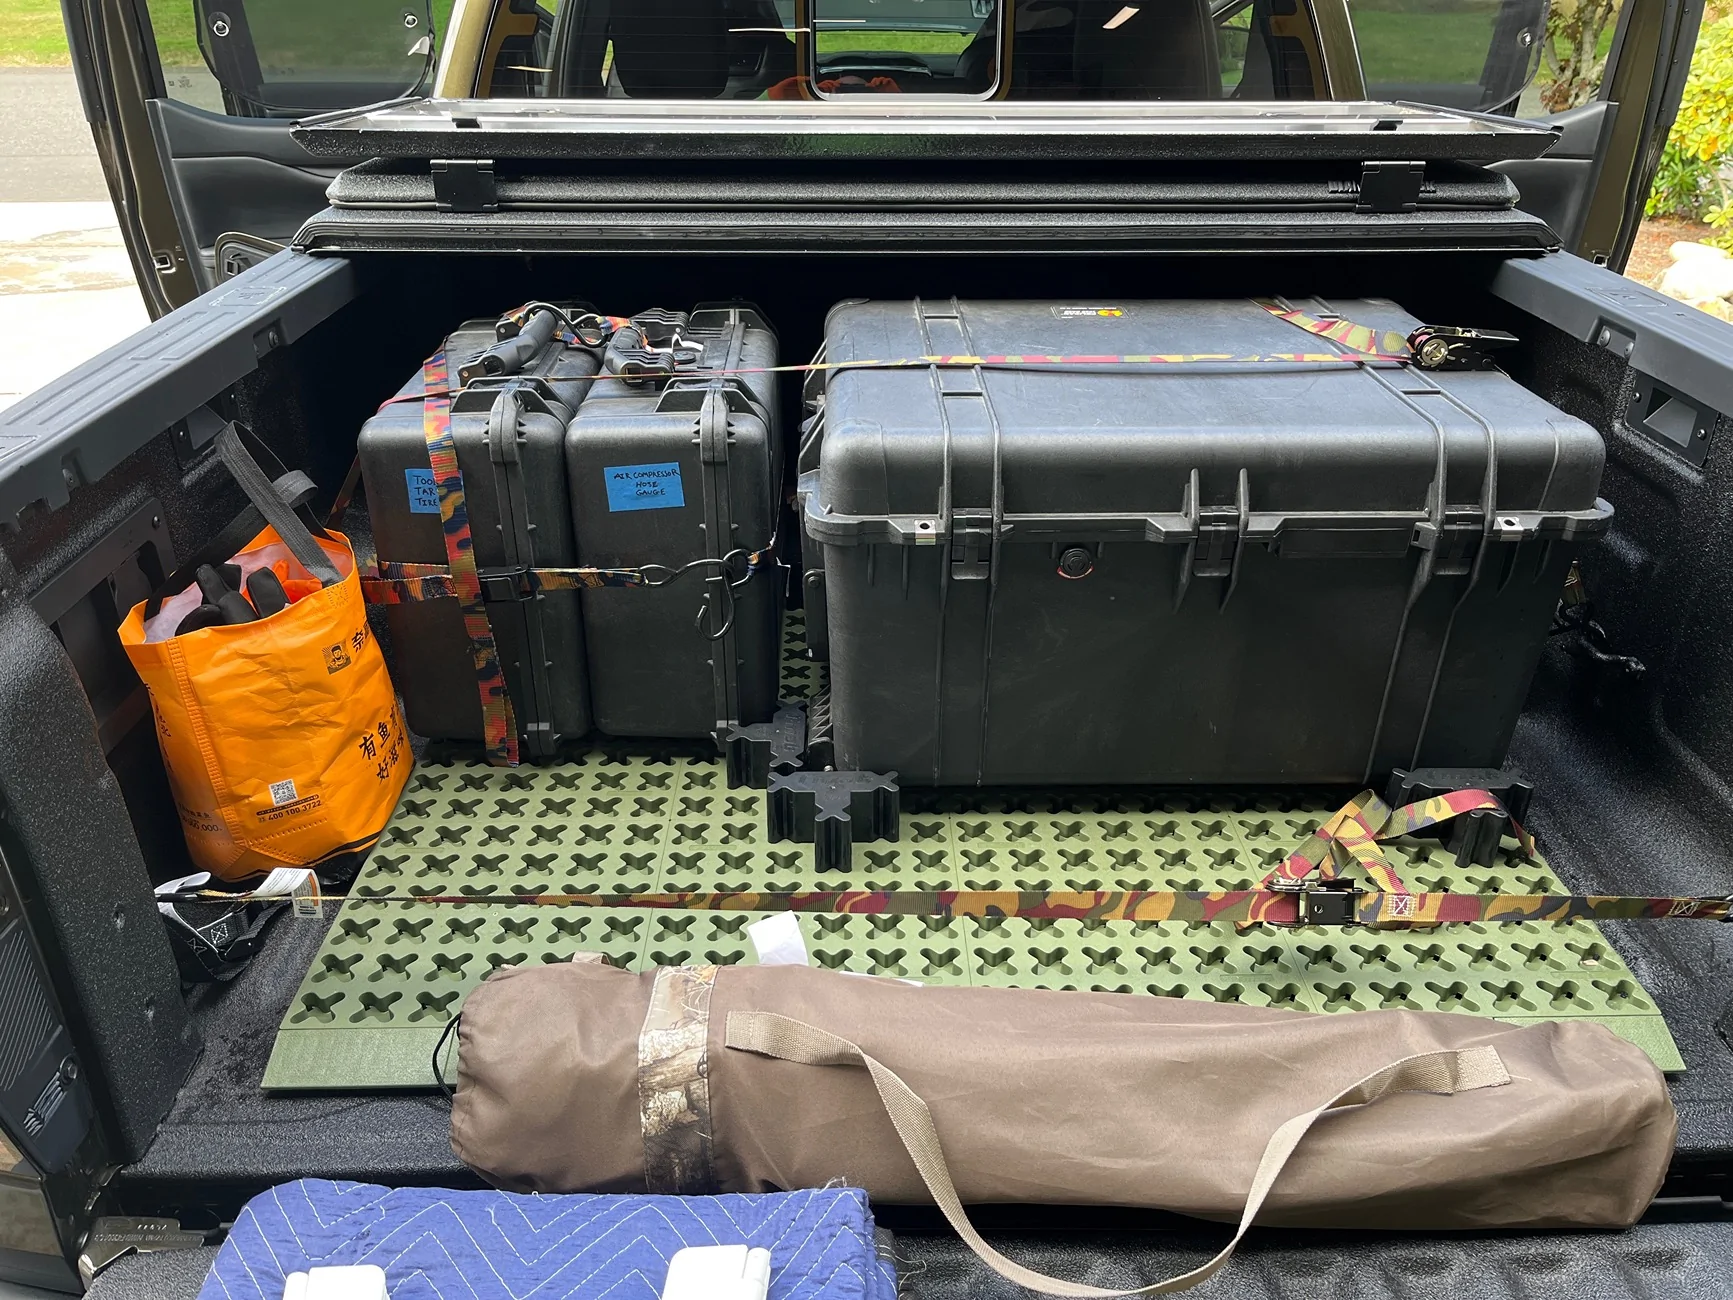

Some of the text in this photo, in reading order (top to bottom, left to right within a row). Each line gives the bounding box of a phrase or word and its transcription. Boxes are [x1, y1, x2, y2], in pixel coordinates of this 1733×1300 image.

[613, 468, 681, 480] AIR COMPRESSOR
[635, 480, 659, 488] HOSE
[635, 488, 666, 496] GAUGE
[268, 811, 284, 822] 400
[285, 806, 301, 817] 100
[301, 800, 322, 813] 3722
